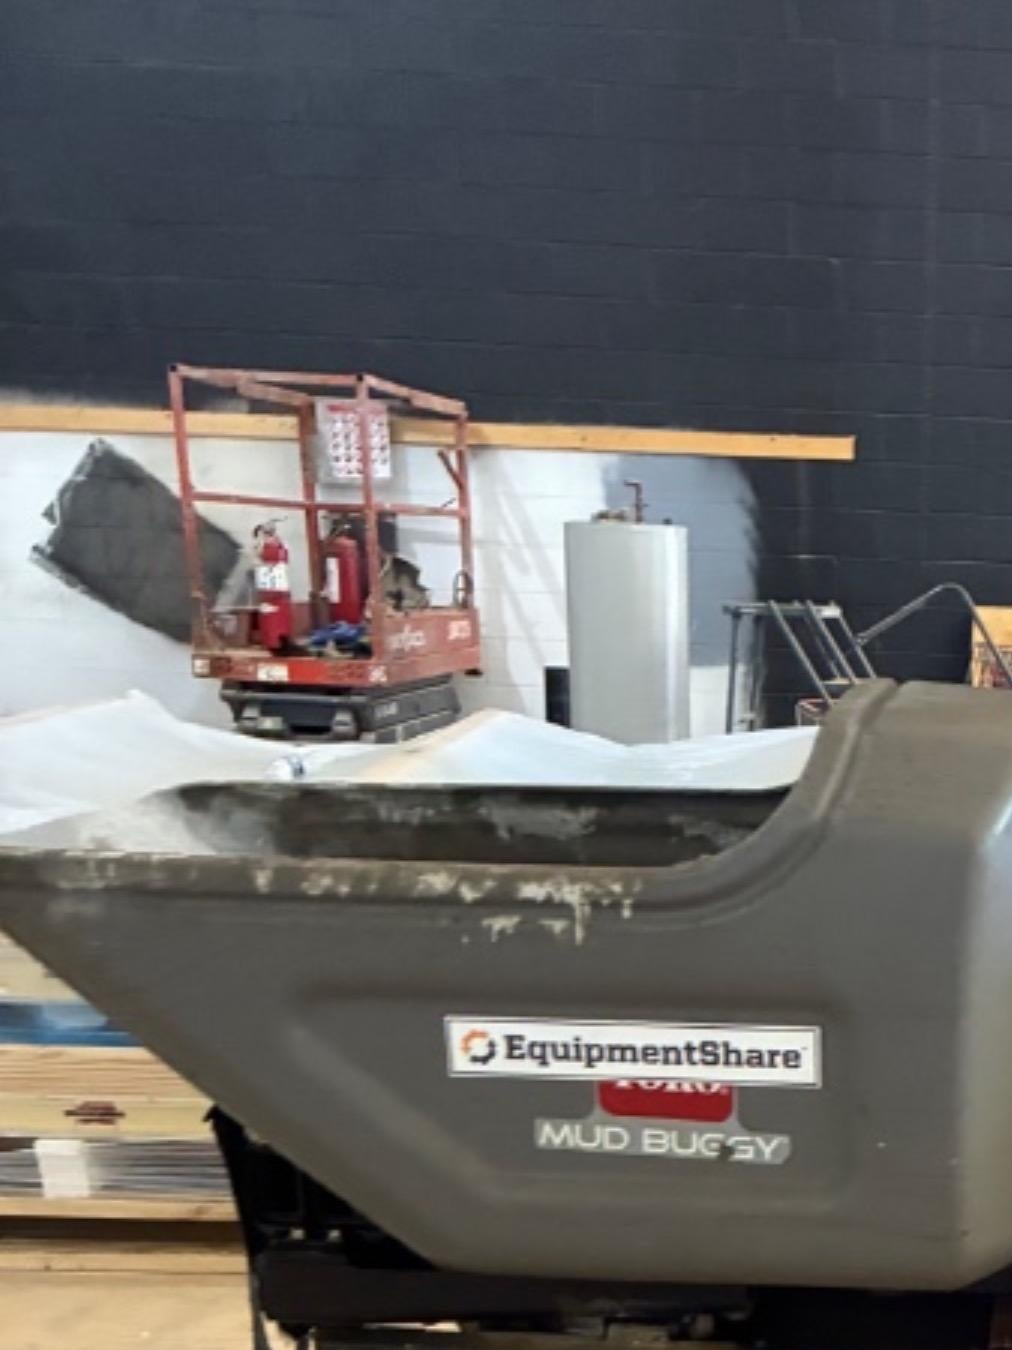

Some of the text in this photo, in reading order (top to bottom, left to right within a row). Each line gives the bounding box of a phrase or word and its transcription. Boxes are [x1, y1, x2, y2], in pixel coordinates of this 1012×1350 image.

[503, 1033, 803, 1070] EquipmentShare
[538, 1121, 781, 1162] MUD BUGGY
